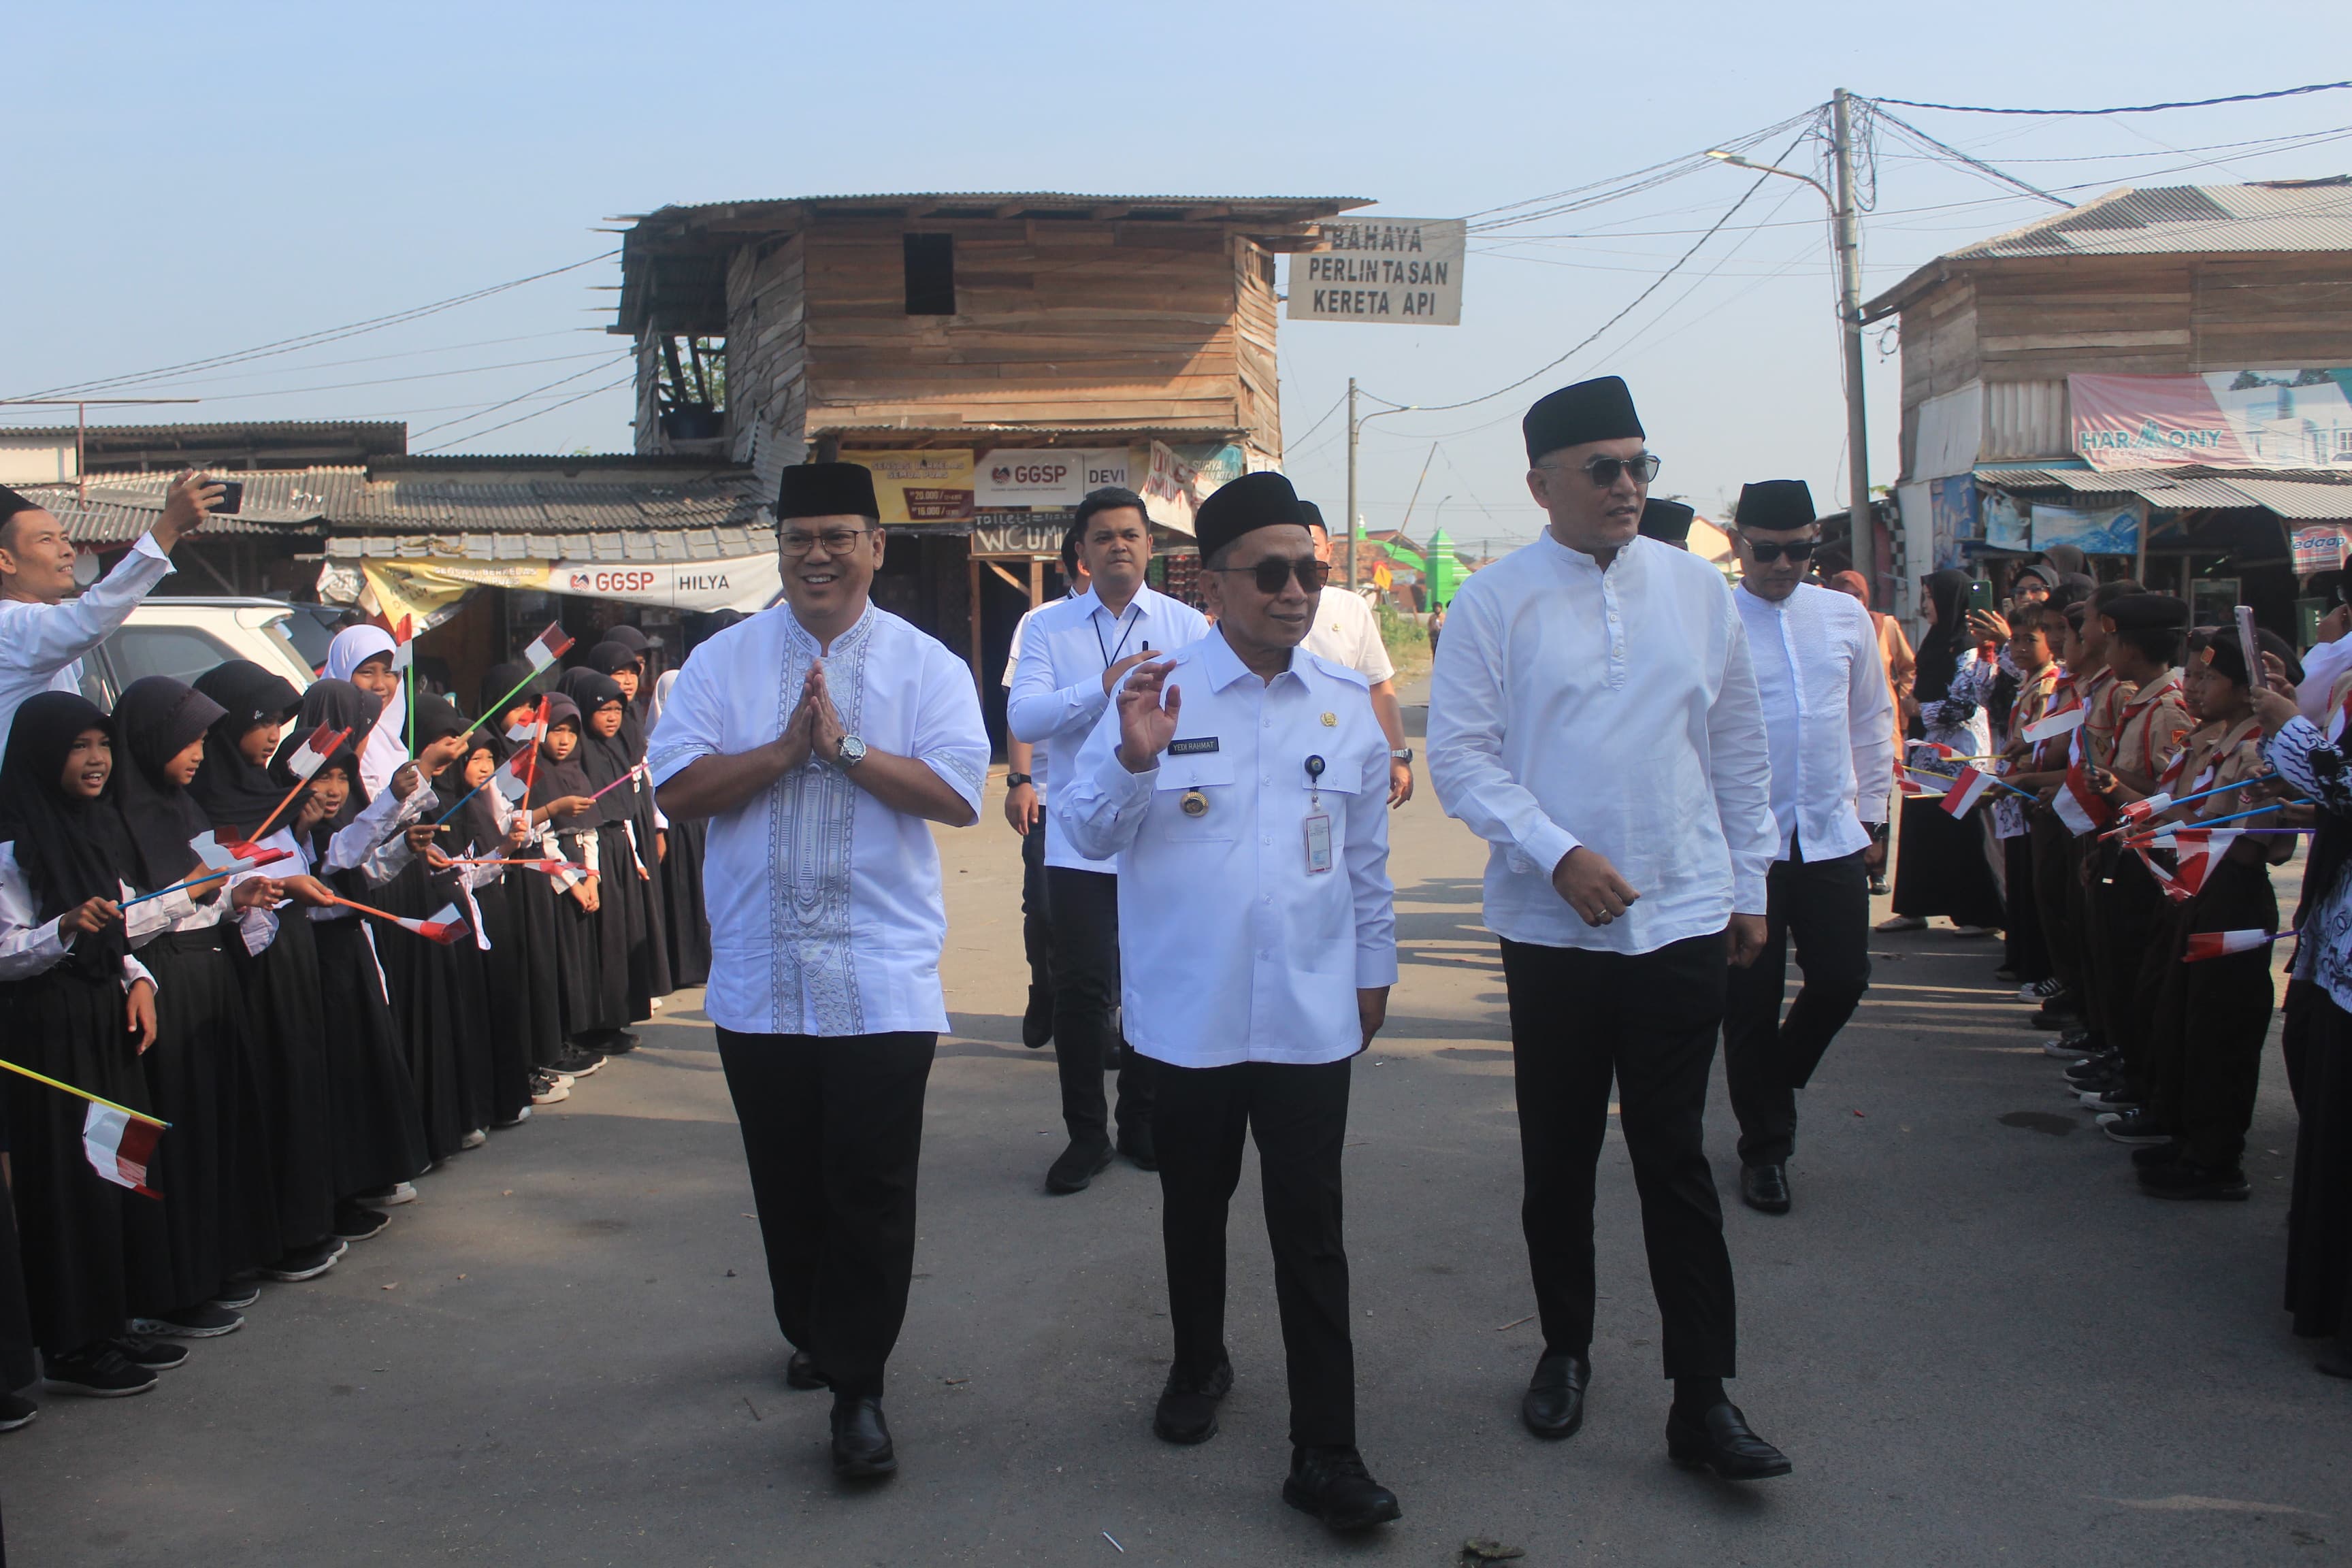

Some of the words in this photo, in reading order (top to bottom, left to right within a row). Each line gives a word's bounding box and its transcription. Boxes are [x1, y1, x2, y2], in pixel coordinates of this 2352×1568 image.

[1332, 225, 1422, 252] BAHAYA
[1309, 257, 1448, 285] PERLINTASAN
[1313, 289, 1390, 314] KERETA
[1402, 292, 1435, 316] API
[1015, 466, 1066, 483] GGSP
[1090, 469, 1125, 483] DEVI
[977, 525, 1023, 551] WC
[2291, 536, 2347, 551] edaap
[596, 572, 654, 591] GGSP
[680, 575, 730, 590] HILYA
[1188, 741, 1215, 750] RAHMAT
